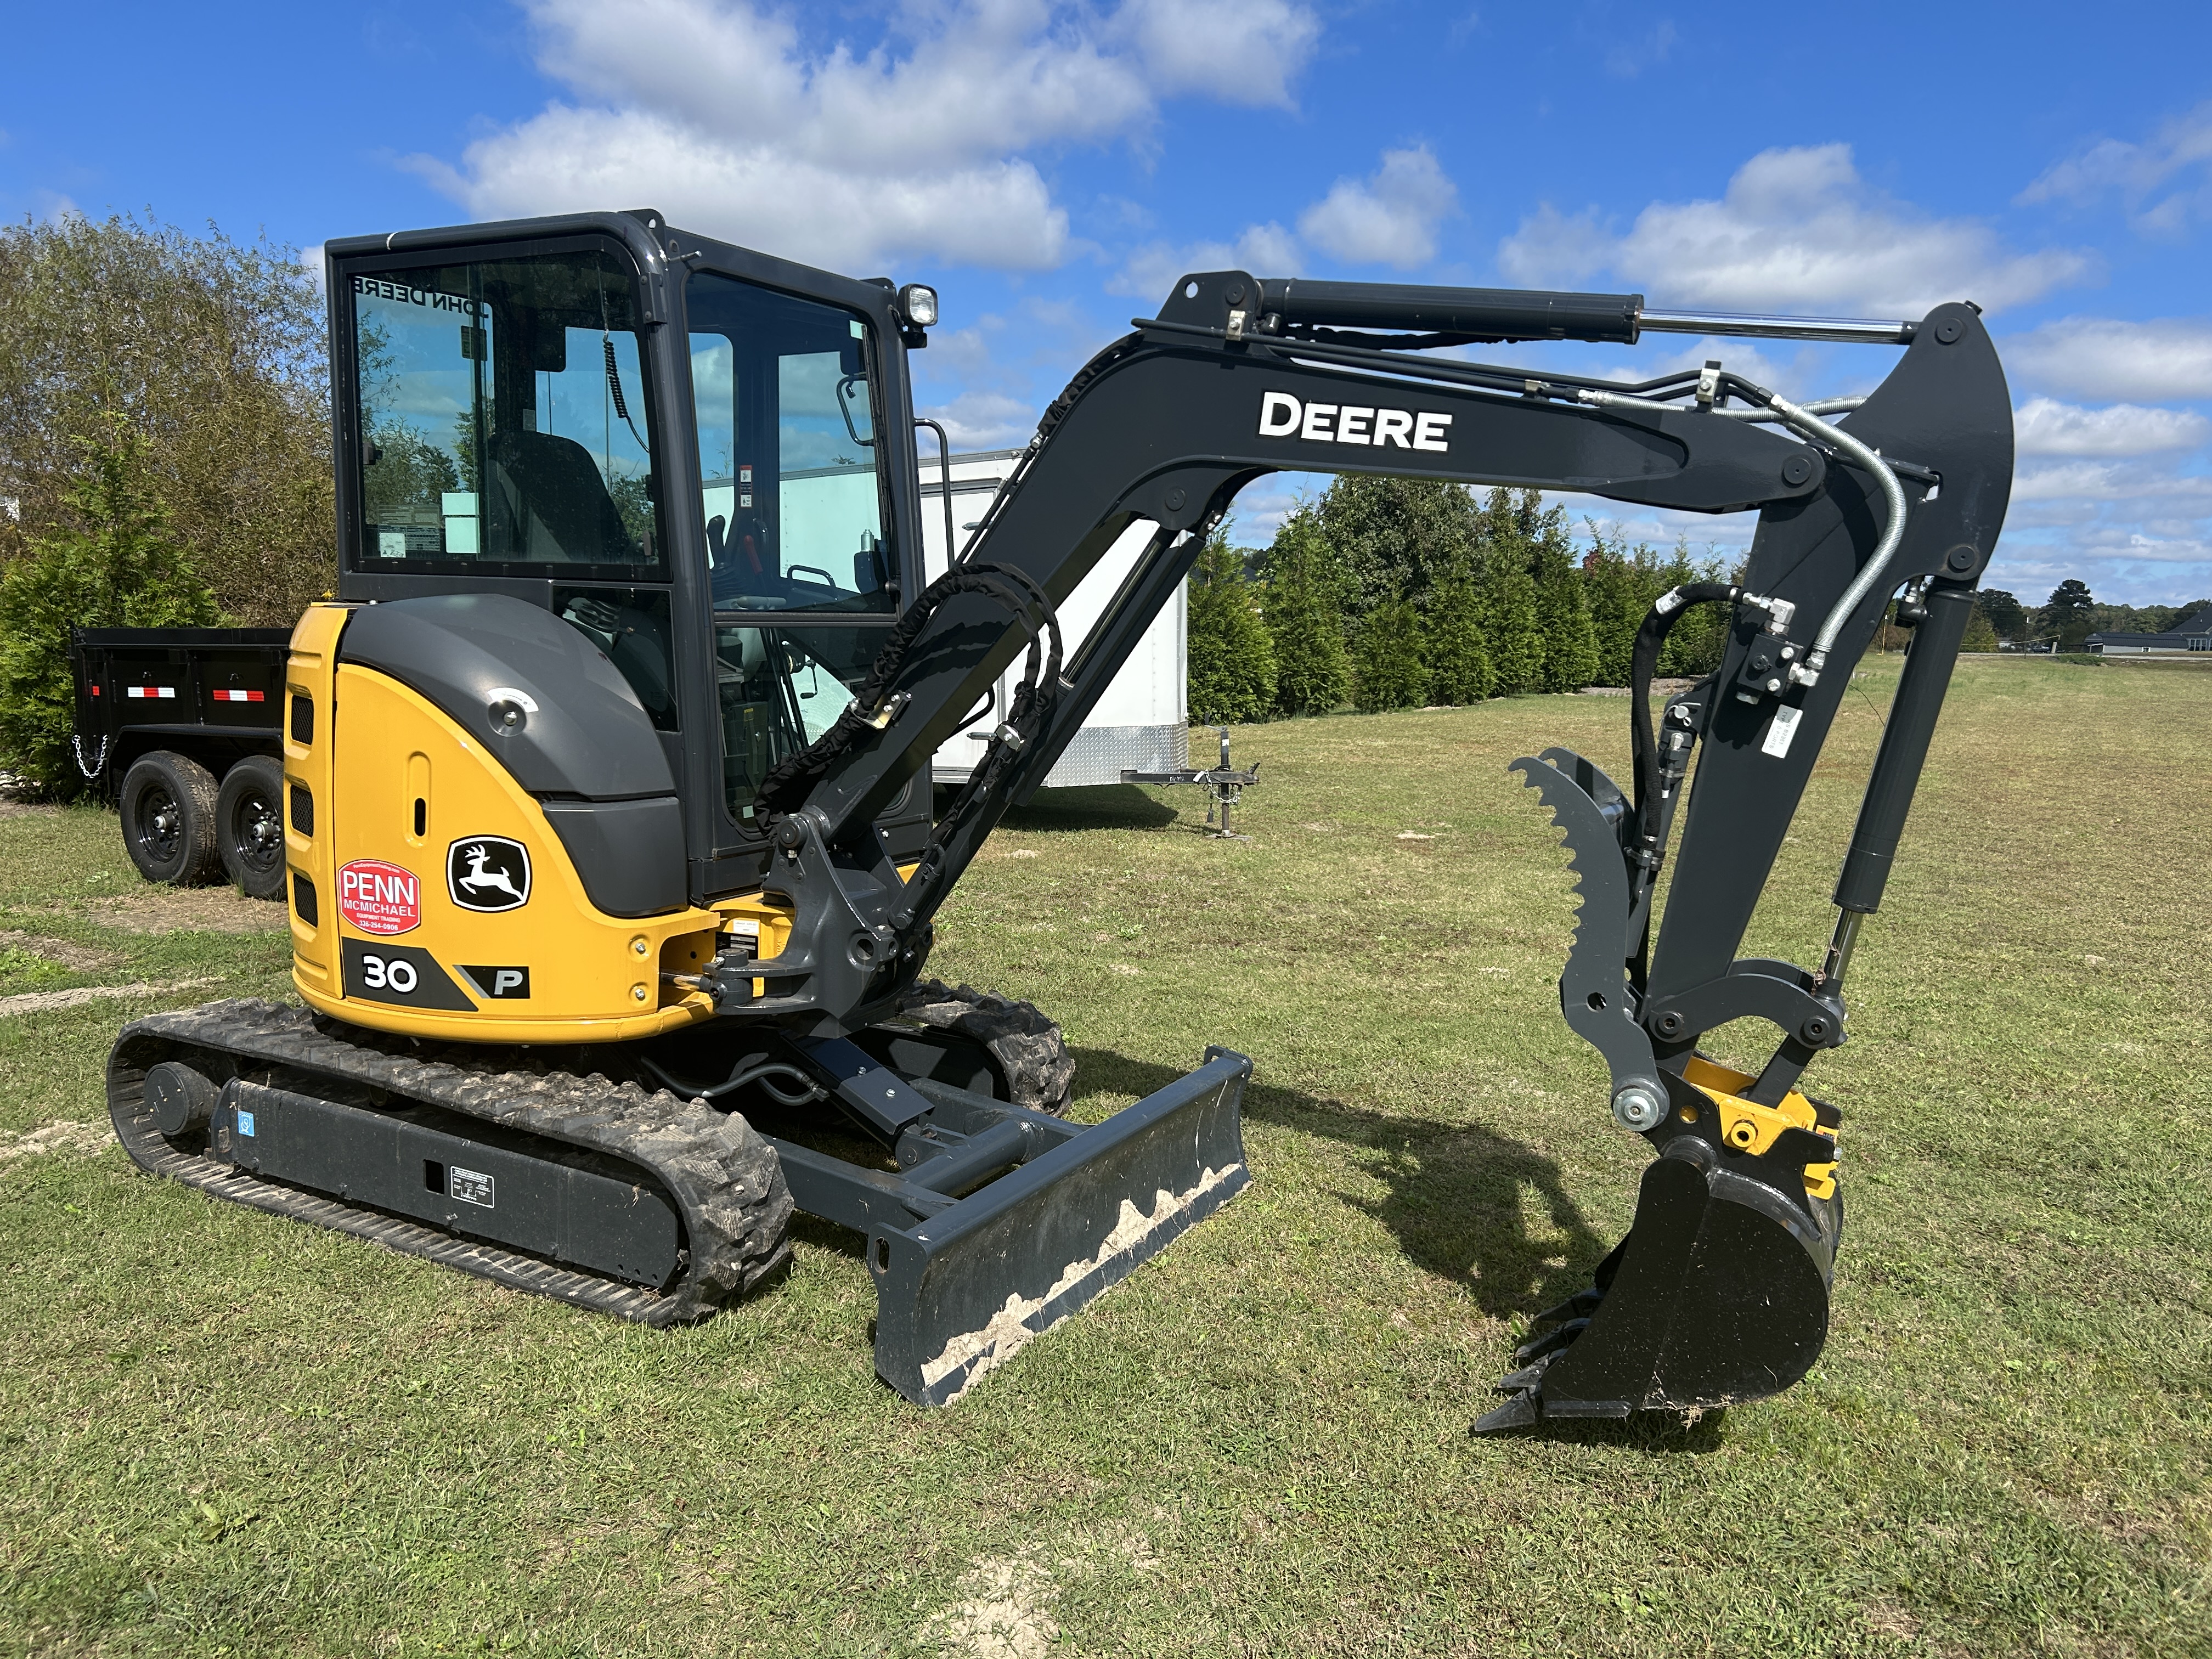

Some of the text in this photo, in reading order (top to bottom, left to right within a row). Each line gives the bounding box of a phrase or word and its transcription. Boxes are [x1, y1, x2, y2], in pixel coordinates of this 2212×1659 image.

[1259, 391, 1453, 452] DEERE
[343, 870, 415, 905] PENN
[344, 899, 416, 917] MCMICHAEL
[363, 955, 523, 995] 30 P
